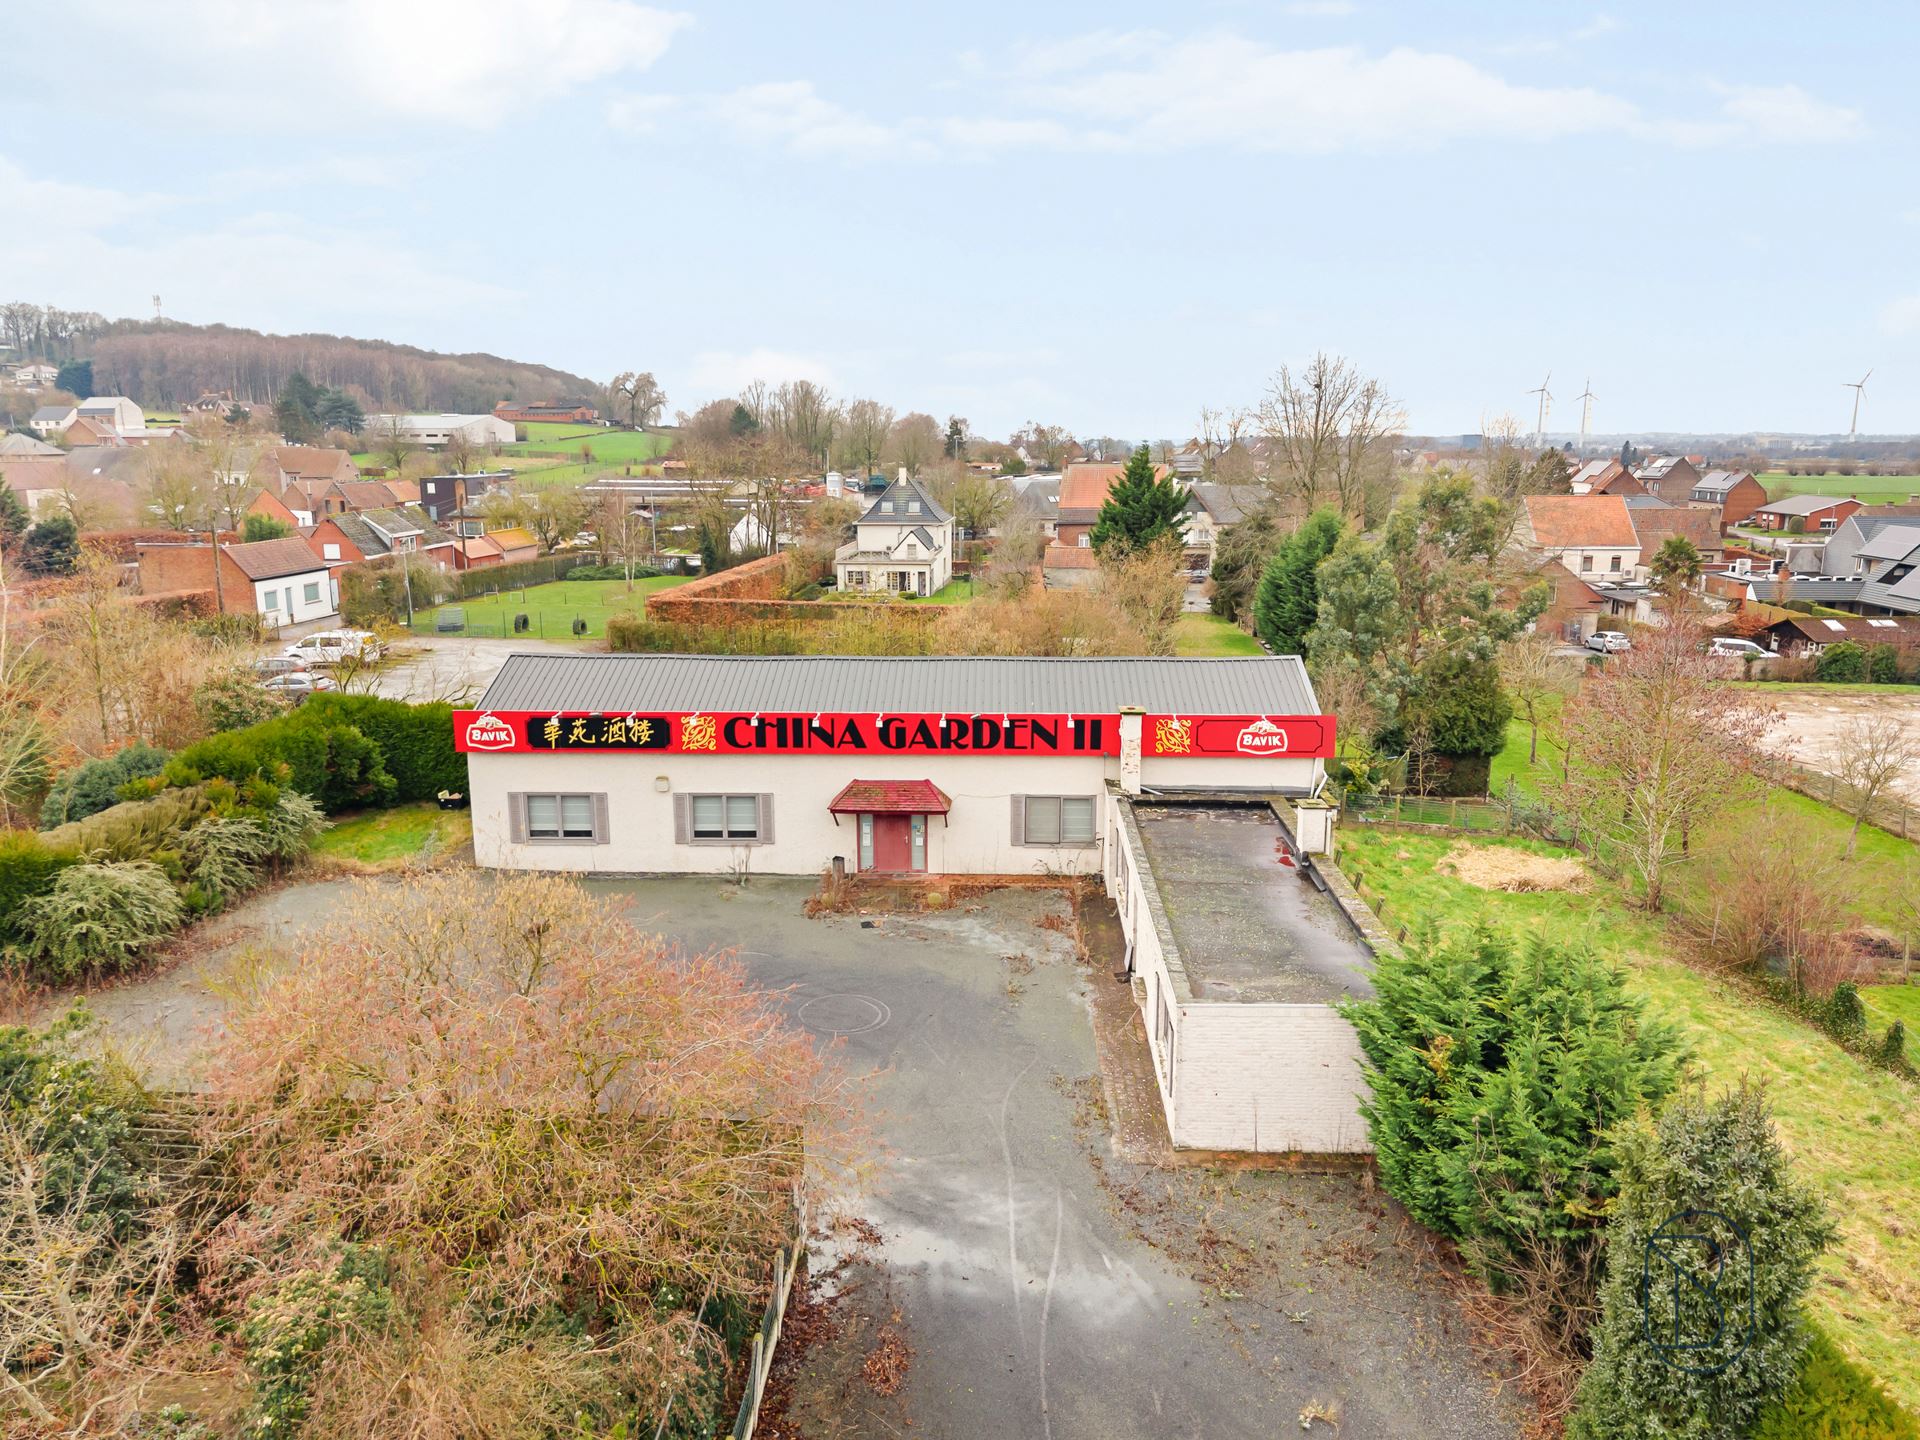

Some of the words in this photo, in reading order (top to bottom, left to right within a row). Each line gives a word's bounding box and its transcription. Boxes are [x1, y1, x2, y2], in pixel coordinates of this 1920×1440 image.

[472, 730, 510, 741] BAVIK
[724, 716, 867, 749] CHINA
[878, 717, 1058, 750] GARDEN
[1073, 719, 1102, 750] II
[1243, 735, 1281, 746] BAVIK
